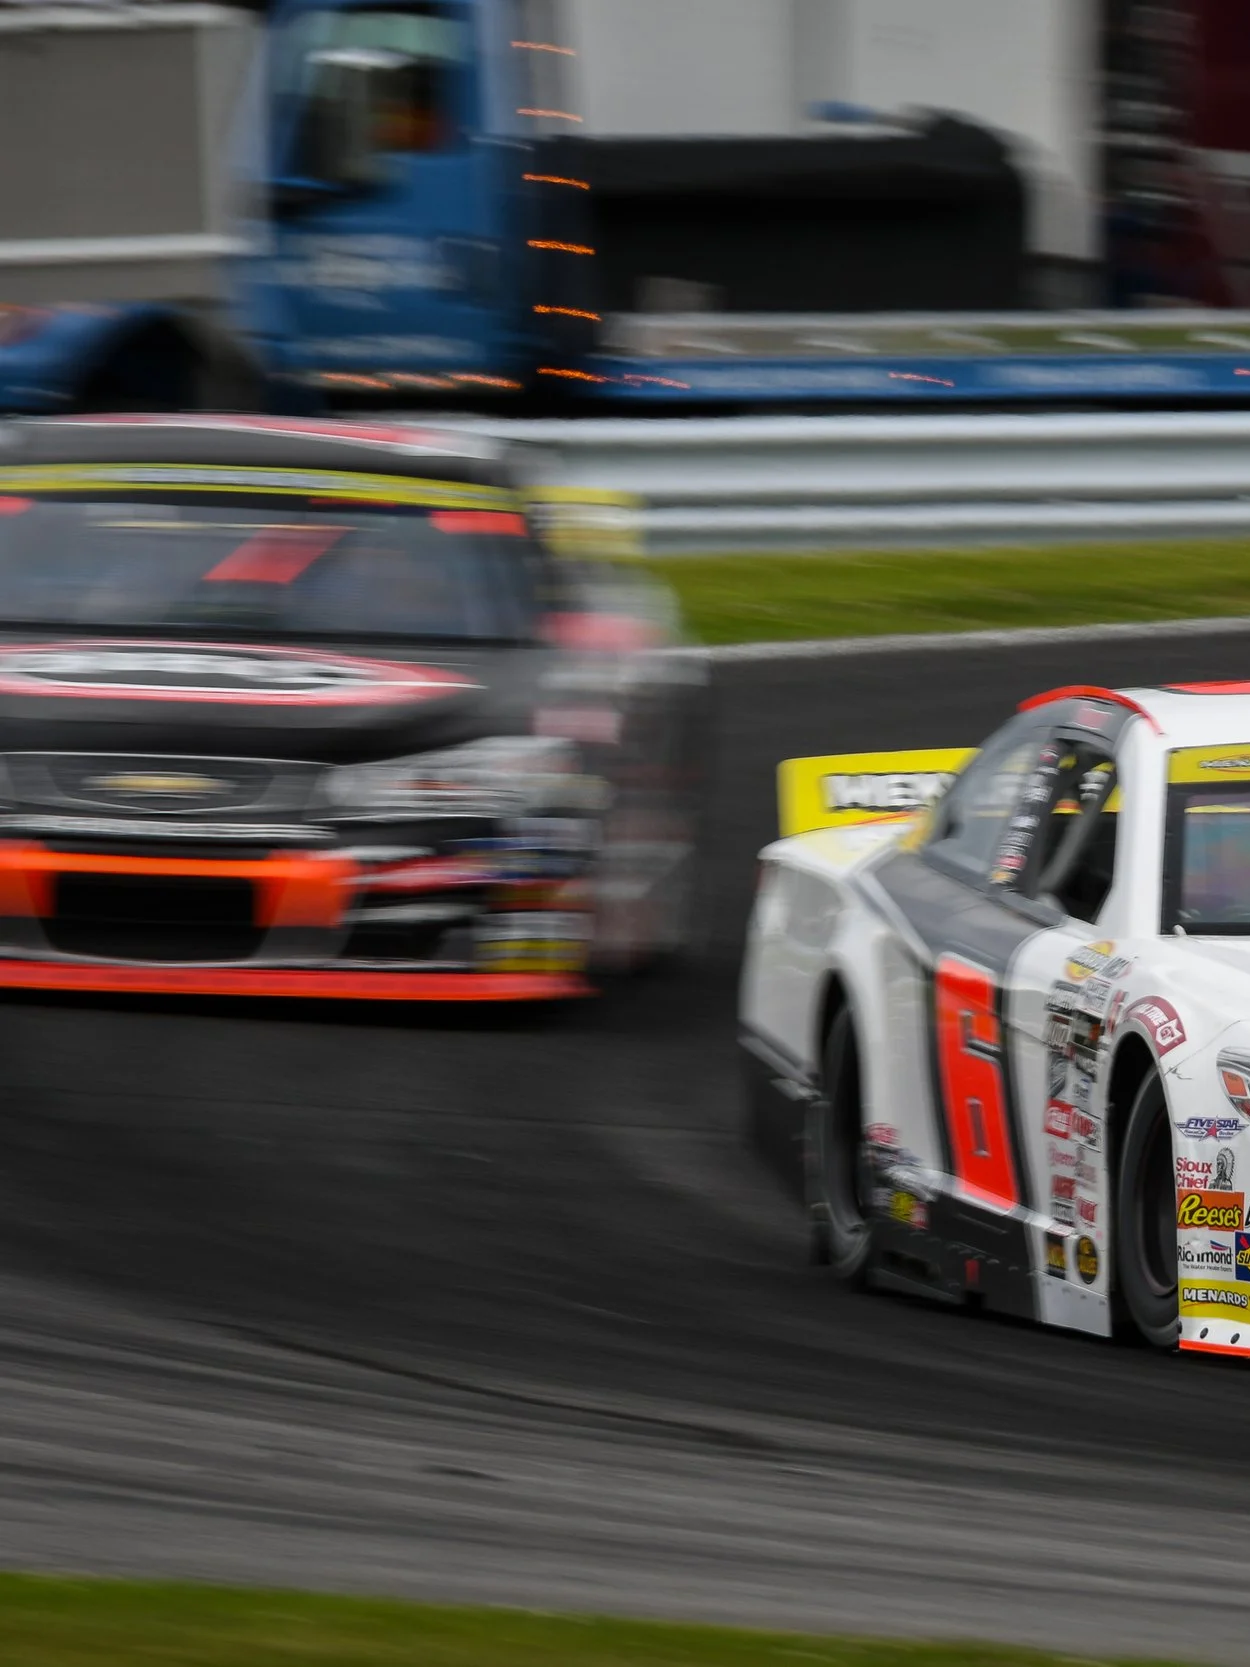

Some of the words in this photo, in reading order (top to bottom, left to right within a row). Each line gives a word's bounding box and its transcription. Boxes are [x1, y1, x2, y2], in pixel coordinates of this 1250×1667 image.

[1187, 1118, 1214, 1129] FIVE
[1216, 1119, 1240, 1131] STAR
[1176, 1156, 1213, 1174] Sioux
[1176, 1173, 1209, 1188] Chief
[1177, 1193, 1242, 1228] Reese's
[1182, 1287, 1249, 1307] MENARDS
